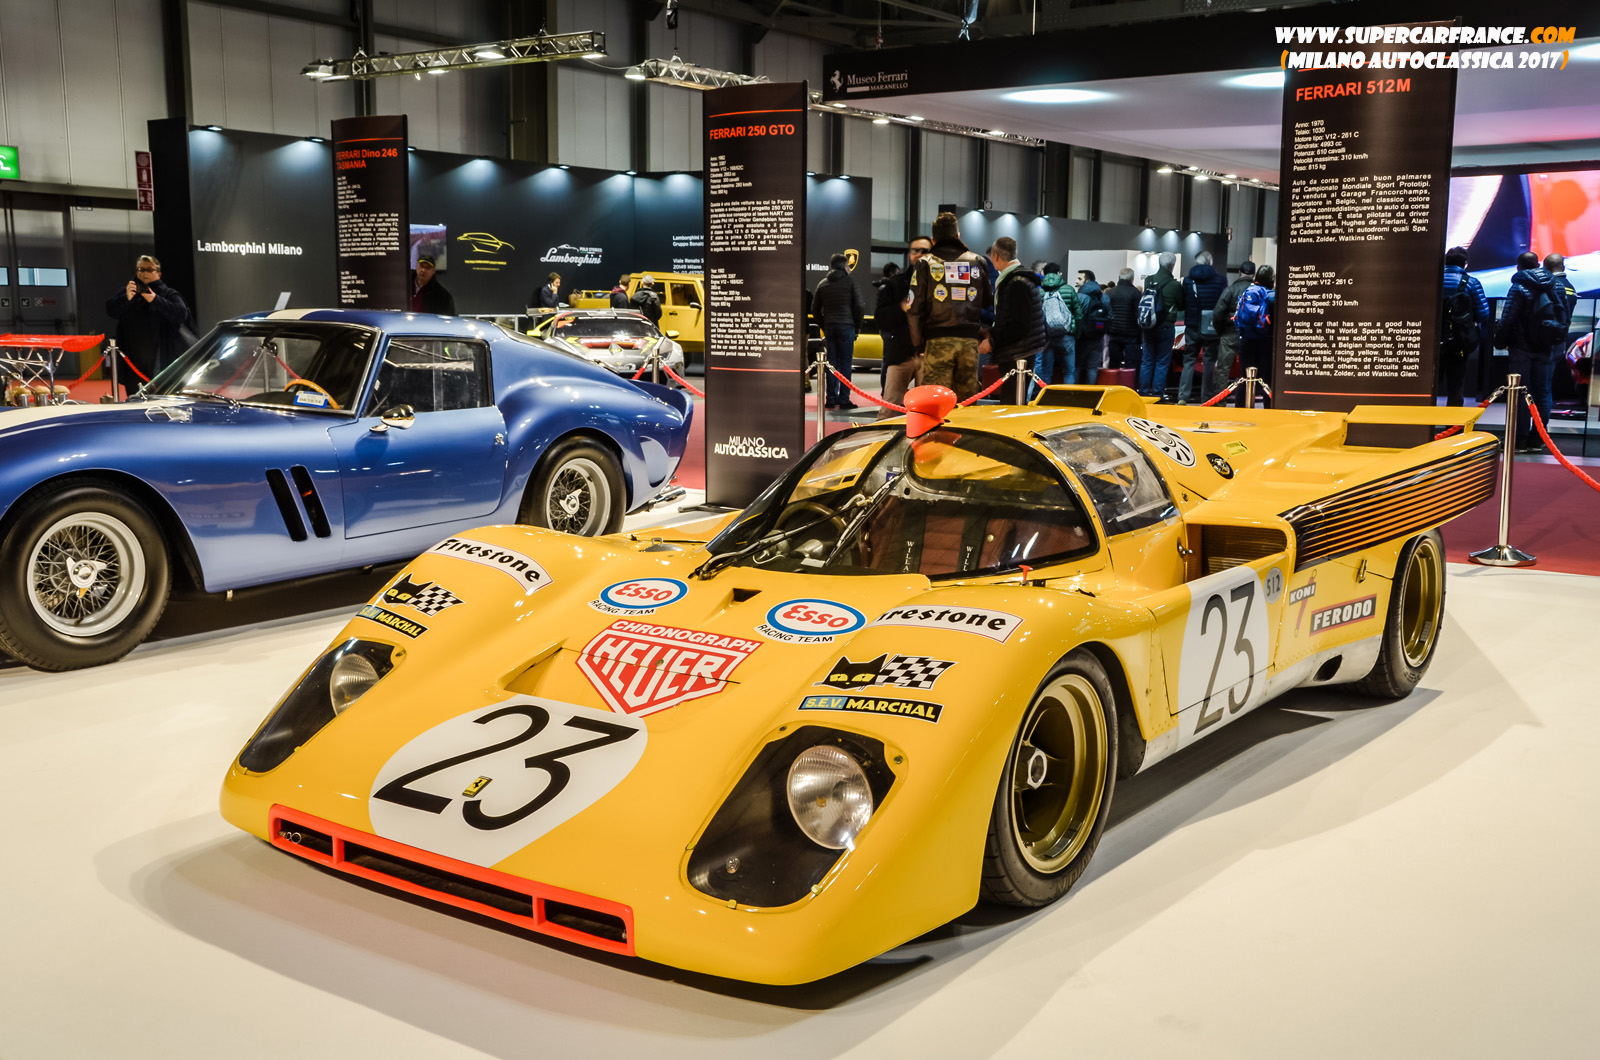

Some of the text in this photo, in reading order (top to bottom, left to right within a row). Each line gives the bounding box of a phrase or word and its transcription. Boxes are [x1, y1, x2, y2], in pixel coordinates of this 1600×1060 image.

[847, 69, 908, 86] Museo Ferrari
[870, 82, 909, 91] MARANELLO
[1296, 77, 1412, 102] FERRARI 512M
[709, 124, 795, 140] FERRARI 250 GTO
[336, 148, 398, 161] FERRARI Dino 246
[336, 160, 367, 170] TASMANIA
[1396, 174, 1432, 182] palmares
[197, 239, 303, 256] Lamborghini Milano
[540, 247, 602, 267] Lamborghini
[811, 263, 830, 271] Milano
[1395, 334, 1421, 342] Garage
[728, 435, 766, 448] MILANO
[714, 442, 789, 459] AUTOCLASSICA
[434, 538, 541, 583] Firestone
[902, 540, 915, 573] WILLA
[1266, 574, 1280, 597] 512
[1290, 584, 1316, 602] KONI
[590, 599, 620, 614] RACING
[1313, 599, 1373, 631] FERODO
[375, 611, 422, 638] MARCHAL
[757, 624, 794, 641] RACING
[611, 620, 761, 652] CHRONOGRAPH
[1193, 580, 1255, 736] 23
[592, 637, 727, 708] HEUER
[805, 698, 936, 719] S.E.V. MARCHAL
[372, 704, 640, 831] 23
